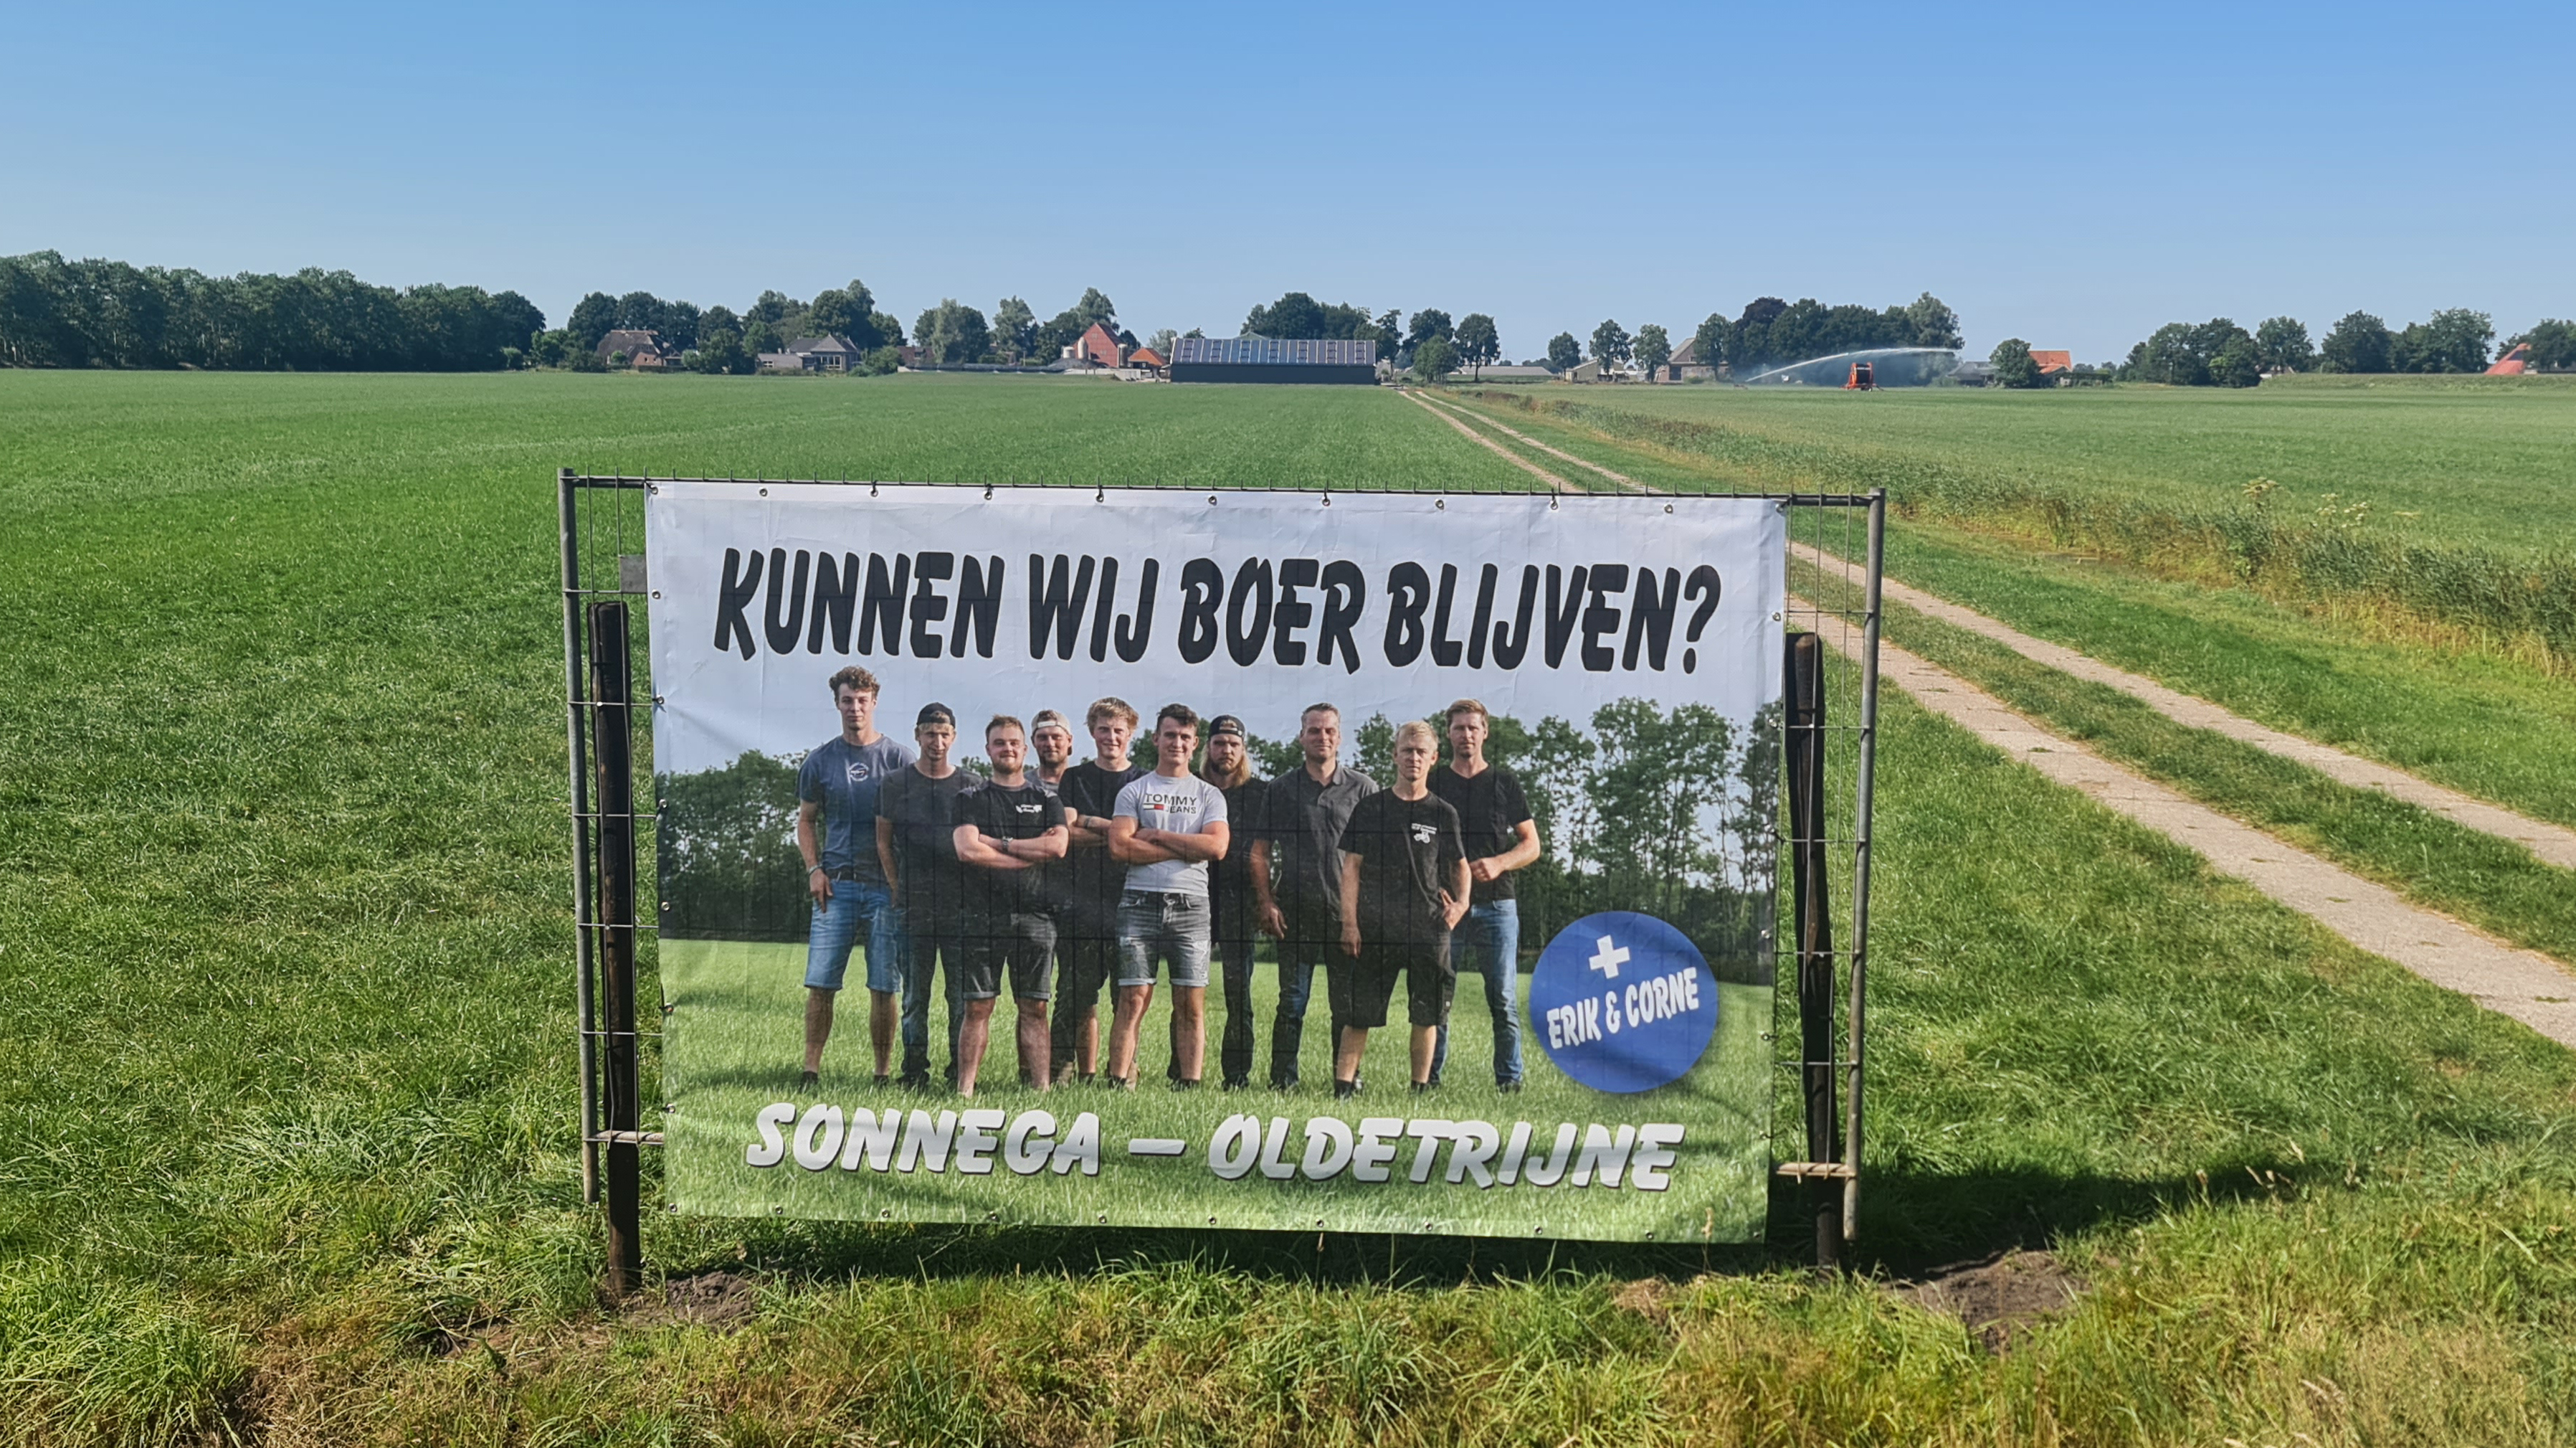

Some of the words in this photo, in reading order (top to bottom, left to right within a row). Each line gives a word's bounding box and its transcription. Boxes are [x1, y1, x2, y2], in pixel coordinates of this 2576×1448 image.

[715, 547, 1005, 661] KUNNEN
[1029, 553, 1159, 663] WIJ
[1178, 557, 1365, 674] BOER
[1384, 562, 1721, 674] BLIJVEN?
[1146, 794, 1197, 805] TOMMY
[1165, 805, 1197, 814] JEANS
[1546, 997, 1602, 1049] ERIK
[1605, 990, 1620, 1034] &
[1625, 967, 1699, 1028] CORNE
[746, 1102, 1101, 1176] SONNEGA
[1208, 1114, 1686, 1191] OLDETRIJNE
